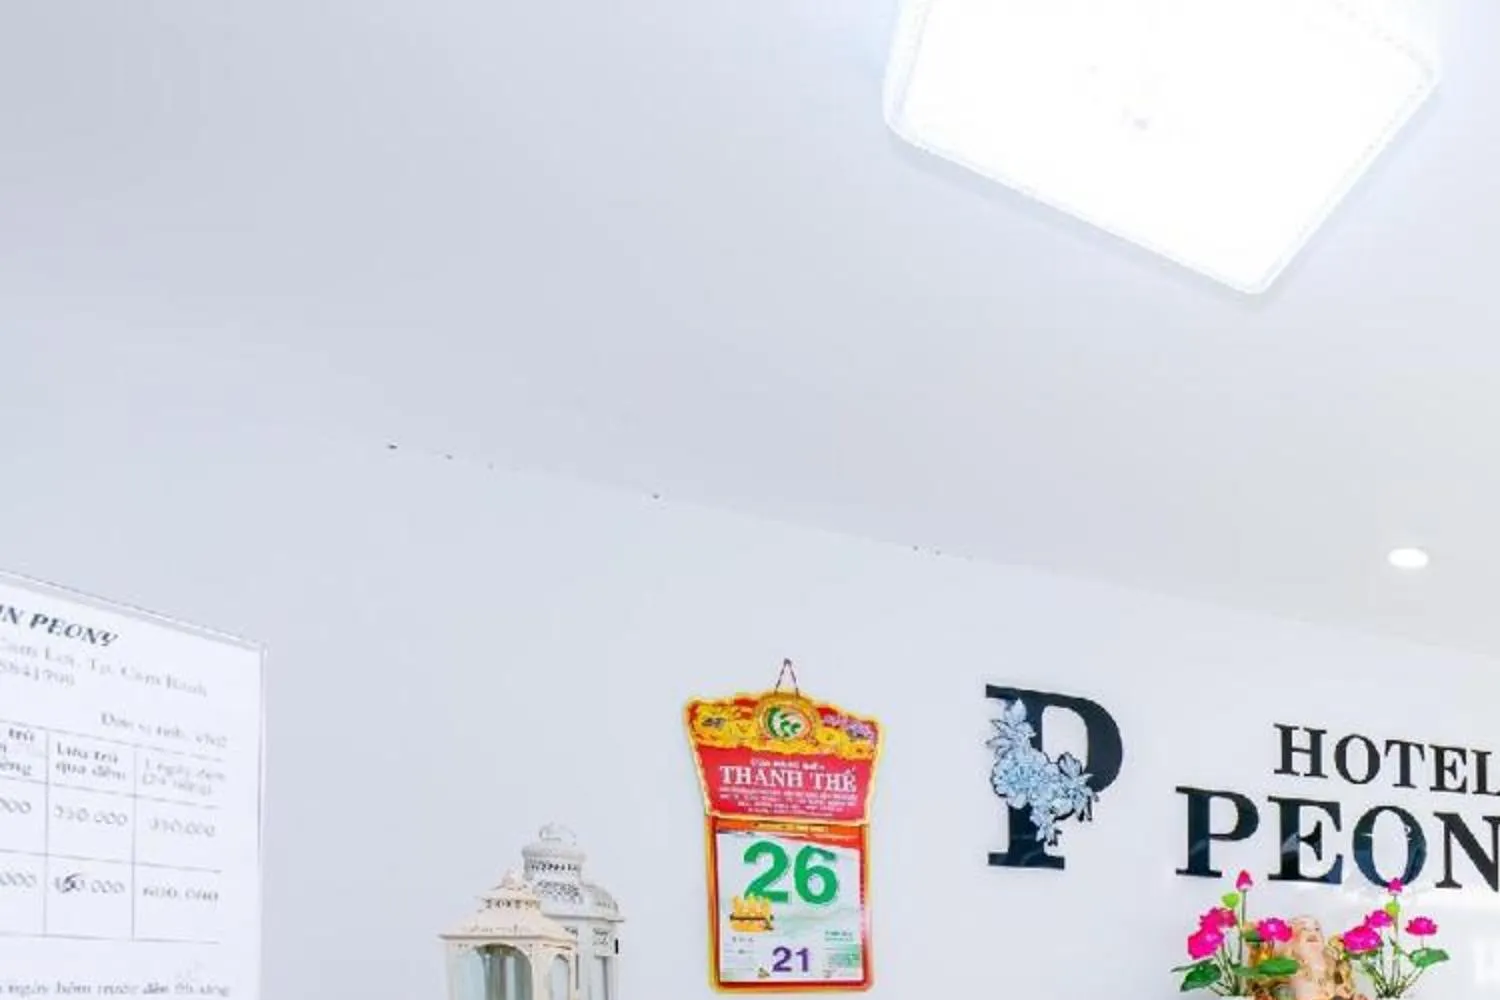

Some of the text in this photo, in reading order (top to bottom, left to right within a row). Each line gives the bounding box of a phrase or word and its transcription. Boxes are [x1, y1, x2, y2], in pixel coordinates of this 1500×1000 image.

[29, 613, 118, 647] PEONY
[720, 765, 804, 788] THANH
[985, 684, 1123, 870] P
[743, 840, 839, 905] 26
[772, 946, 811, 973] 21
